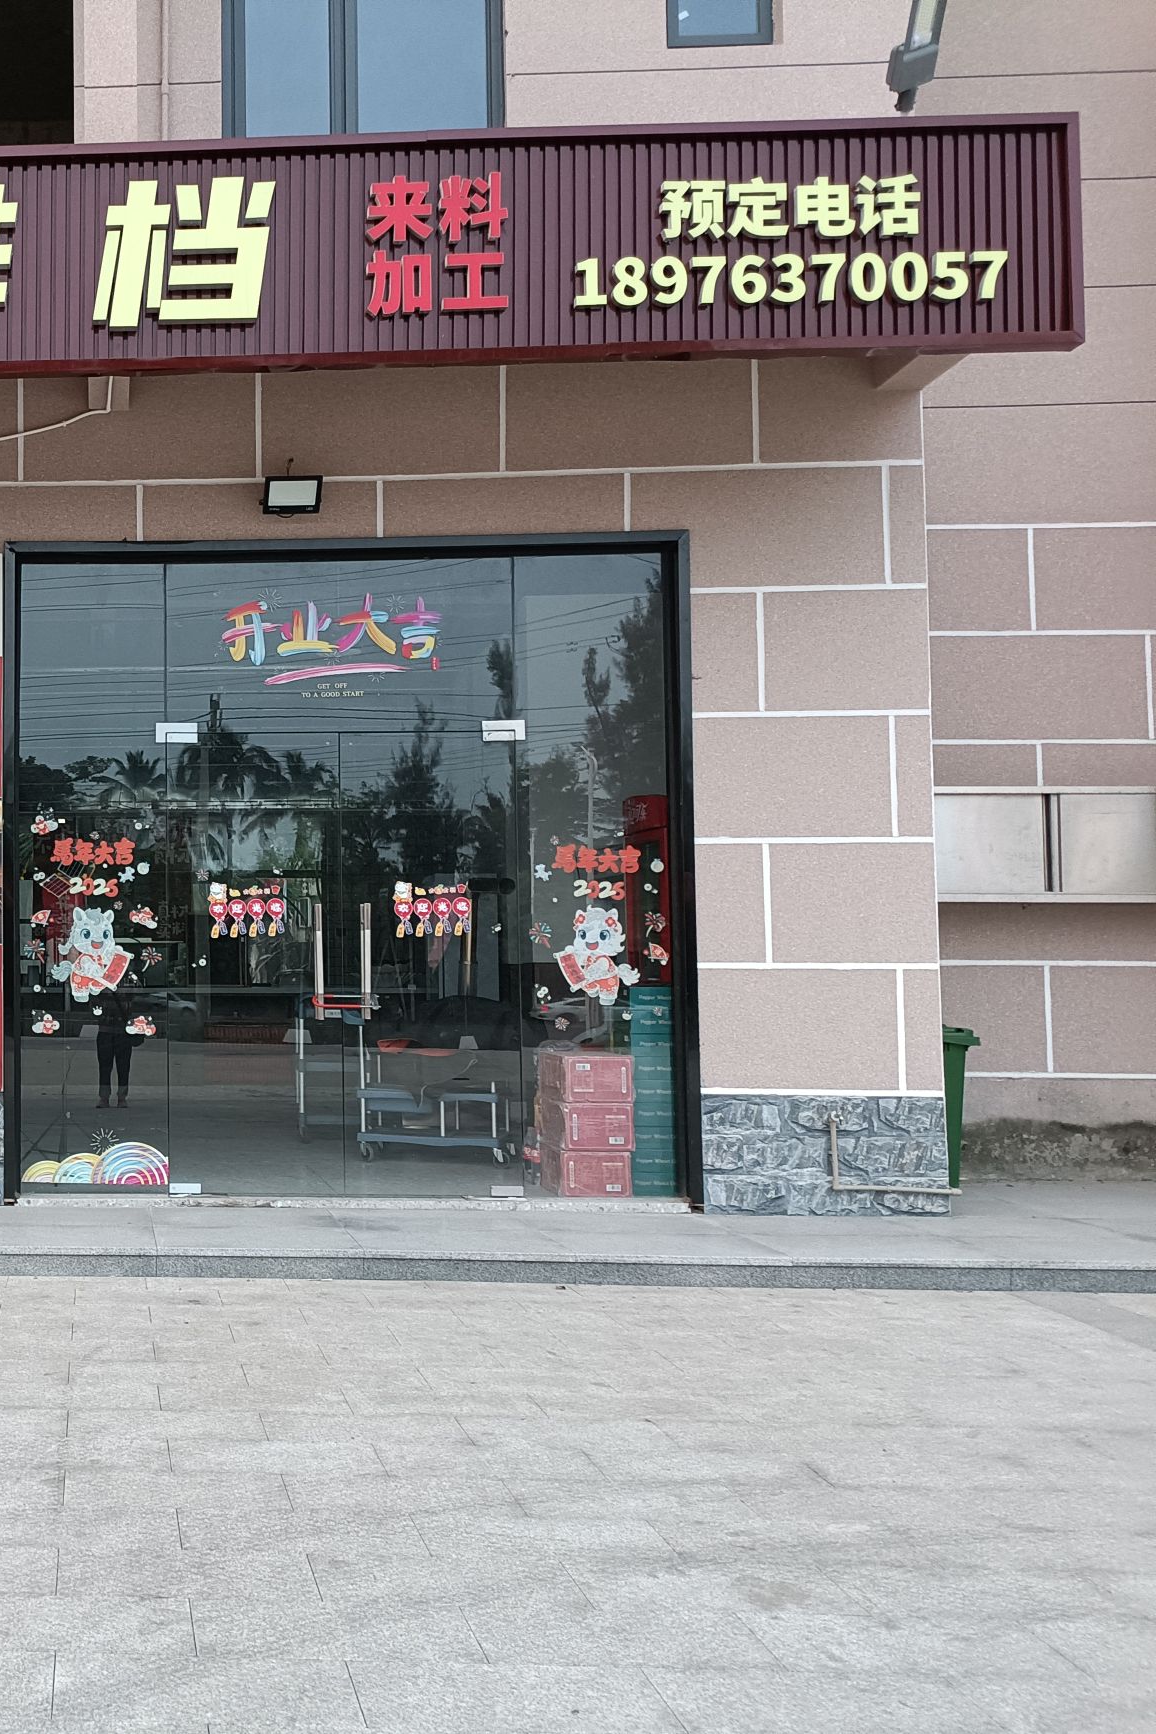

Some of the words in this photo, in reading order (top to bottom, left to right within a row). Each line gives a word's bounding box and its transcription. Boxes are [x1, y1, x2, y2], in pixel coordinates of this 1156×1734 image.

[365, 172, 509, 244] 来料
[659, 173, 921, 242] 预定电话
[365, 251, 509, 318] 加工
[573, 250, 1009, 310] 18976370057
[221, 592, 442, 666] 开业大吉
[69, 877, 119, 897] 2026
[573, 879, 627, 901] 2026
